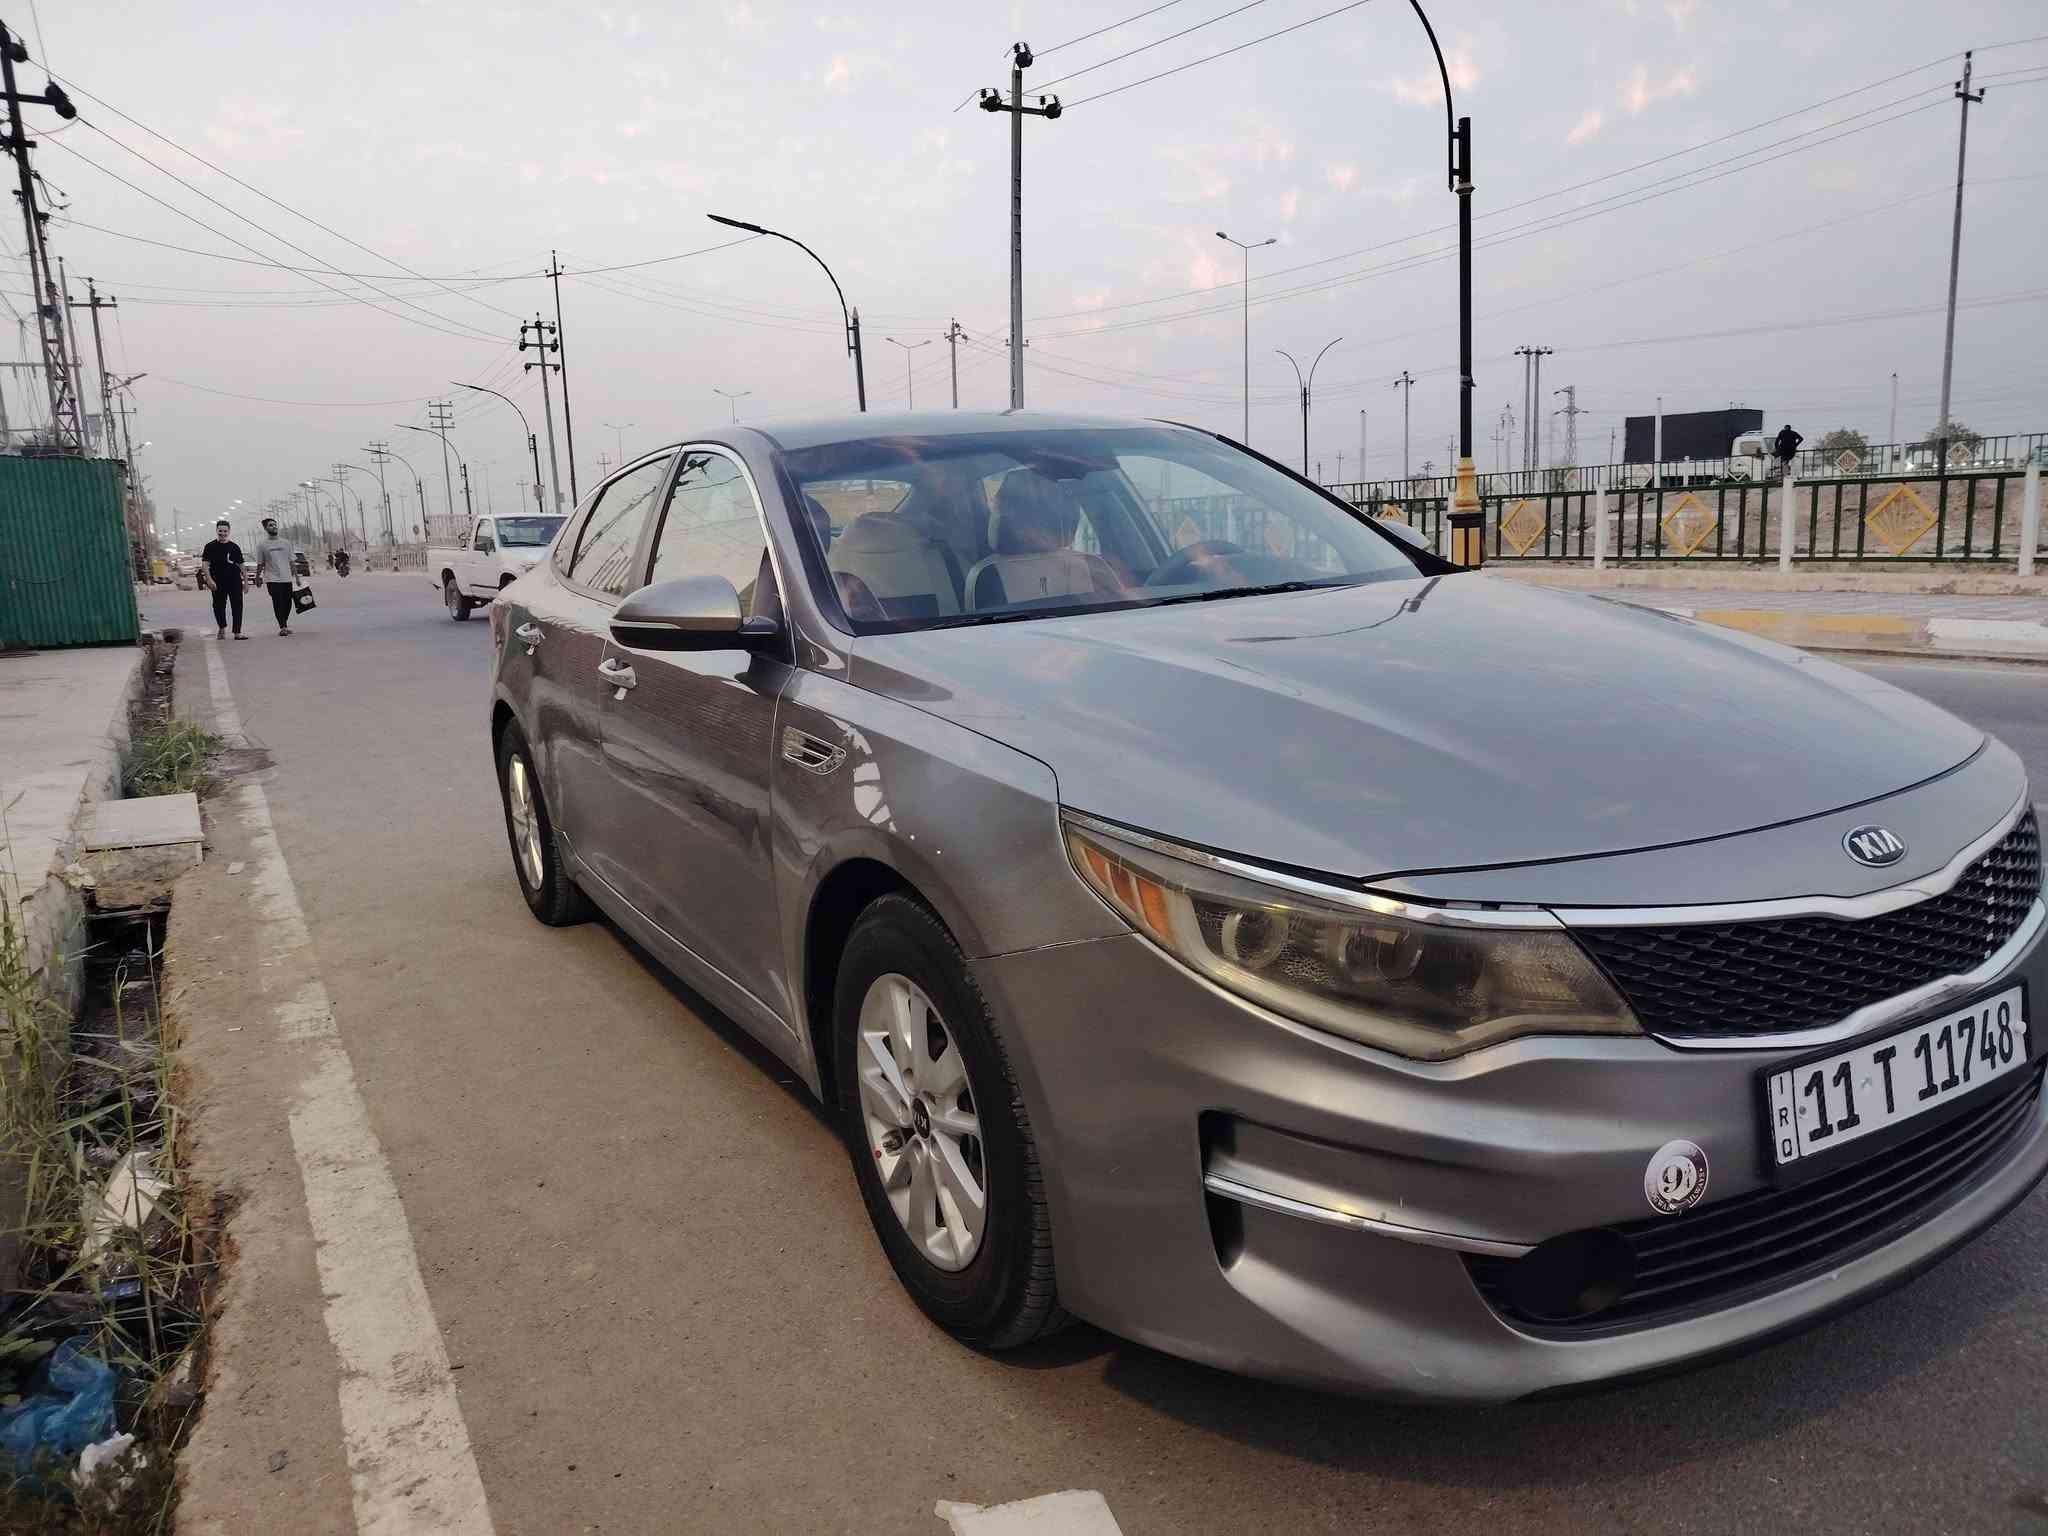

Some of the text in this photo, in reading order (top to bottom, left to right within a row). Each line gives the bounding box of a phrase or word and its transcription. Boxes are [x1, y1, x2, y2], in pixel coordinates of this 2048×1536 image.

[1851, 829, 1903, 859] KIA
[1804, 1000, 2015, 1142] 11 T 11748
